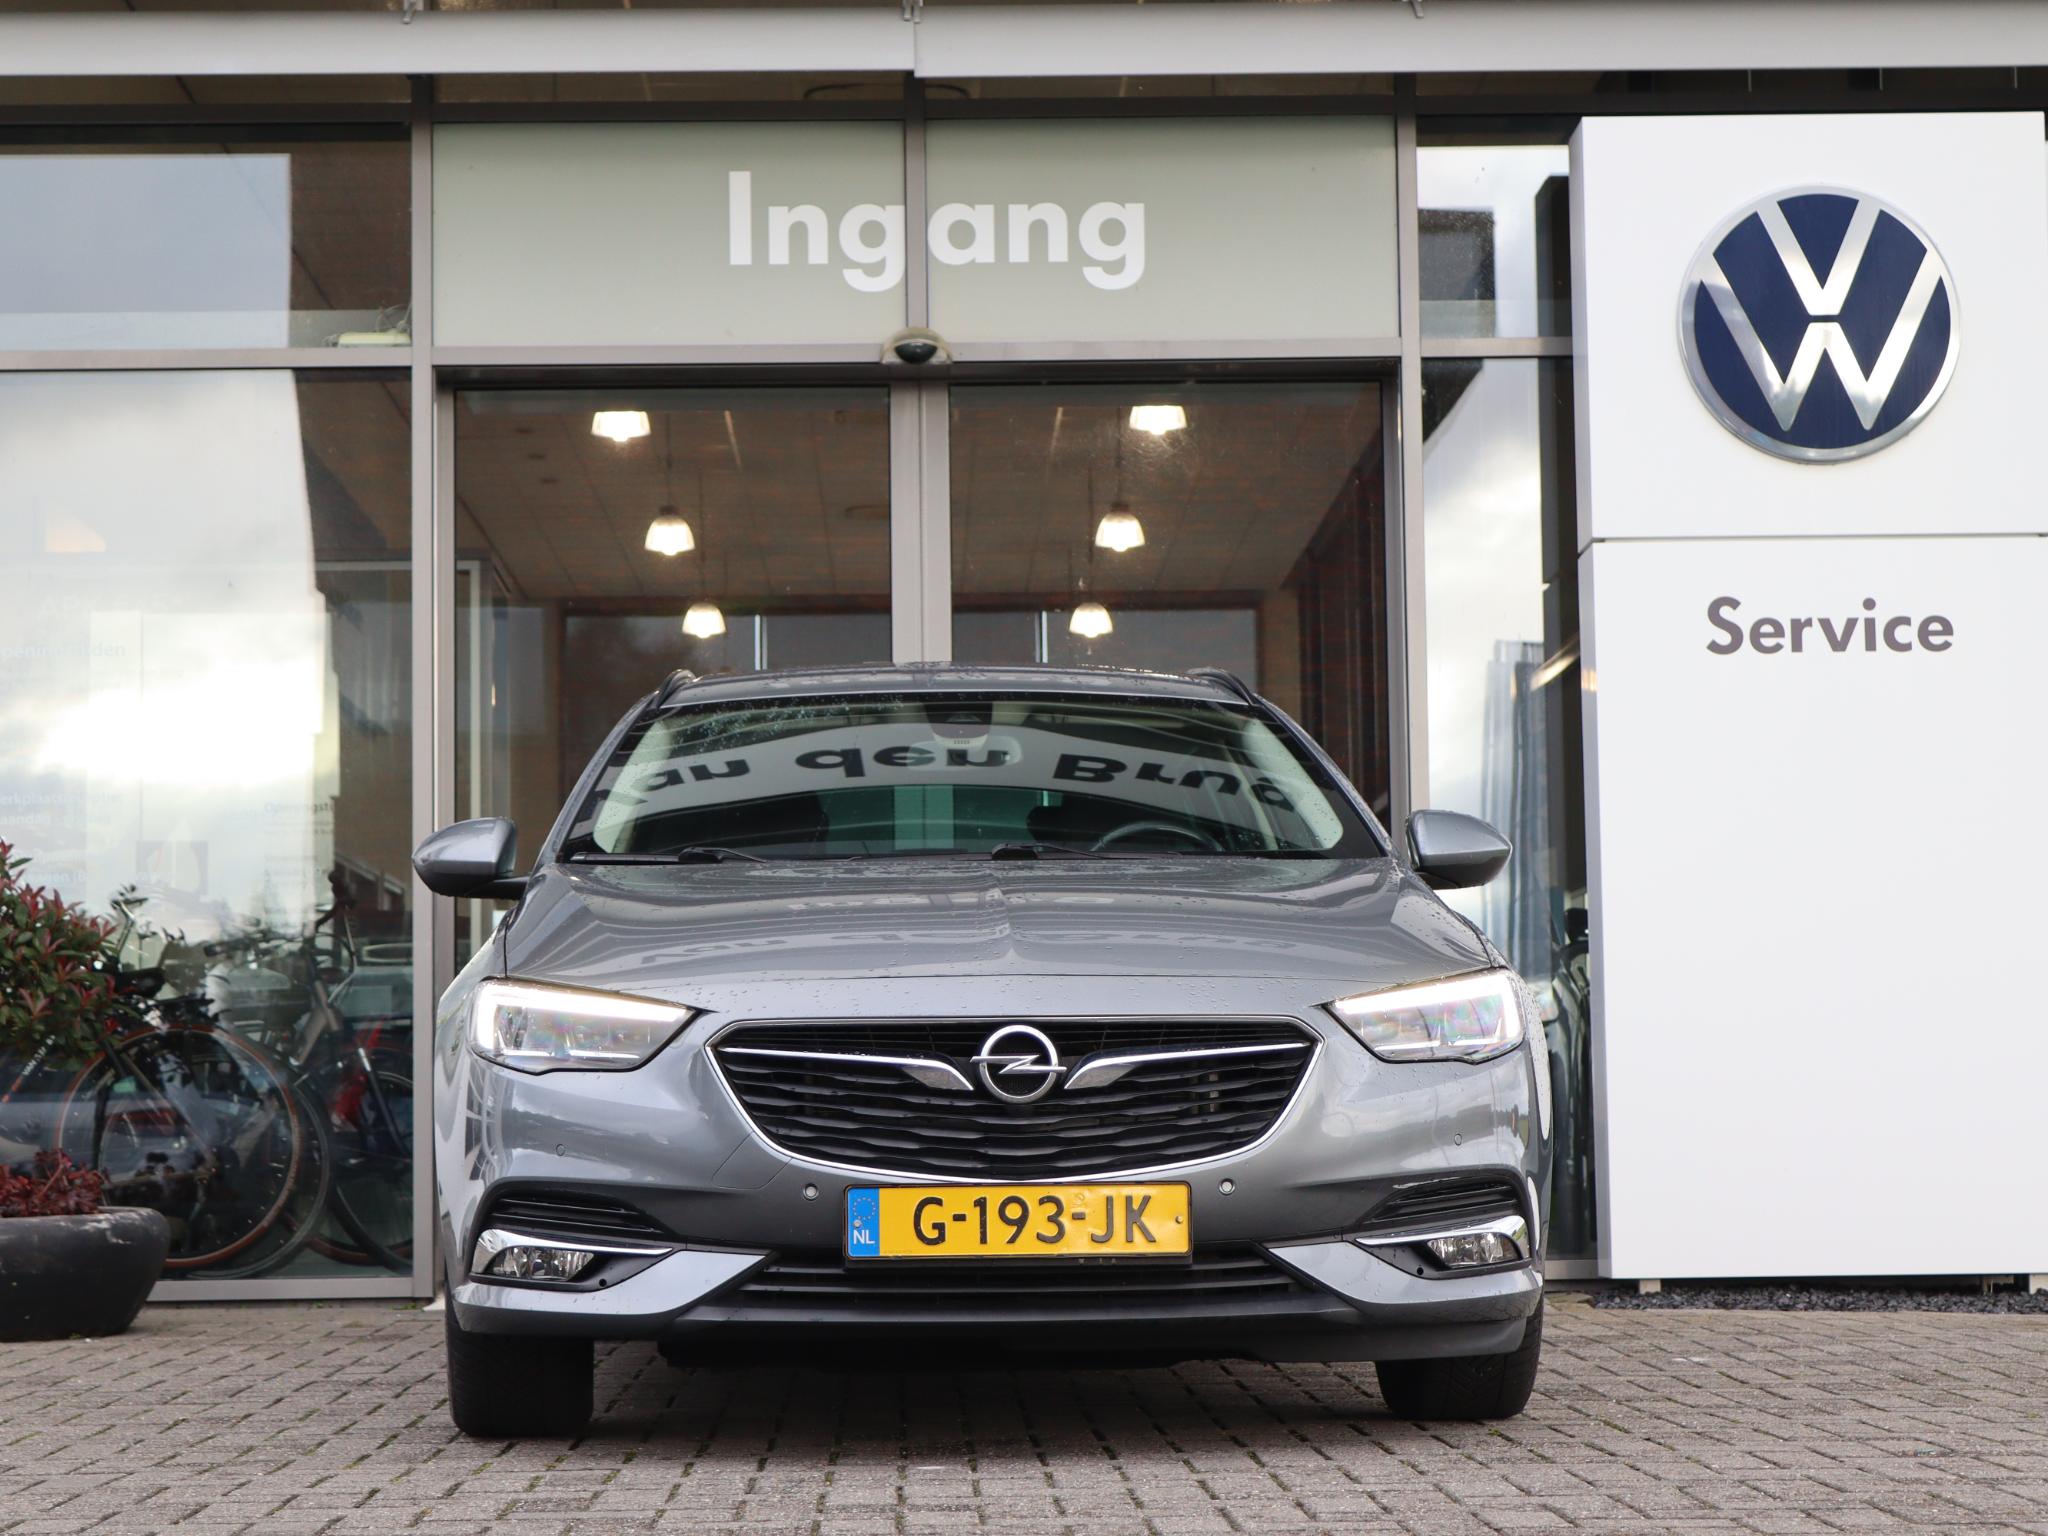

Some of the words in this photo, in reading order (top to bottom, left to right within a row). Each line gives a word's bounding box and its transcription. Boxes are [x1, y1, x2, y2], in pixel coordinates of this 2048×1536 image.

[729, 170, 1145, 292] Ingang
[1706, 596, 1954, 655] Service
[853, 1229, 875, 1245] NL
[913, 1194, 1157, 1246] G-193-JK
